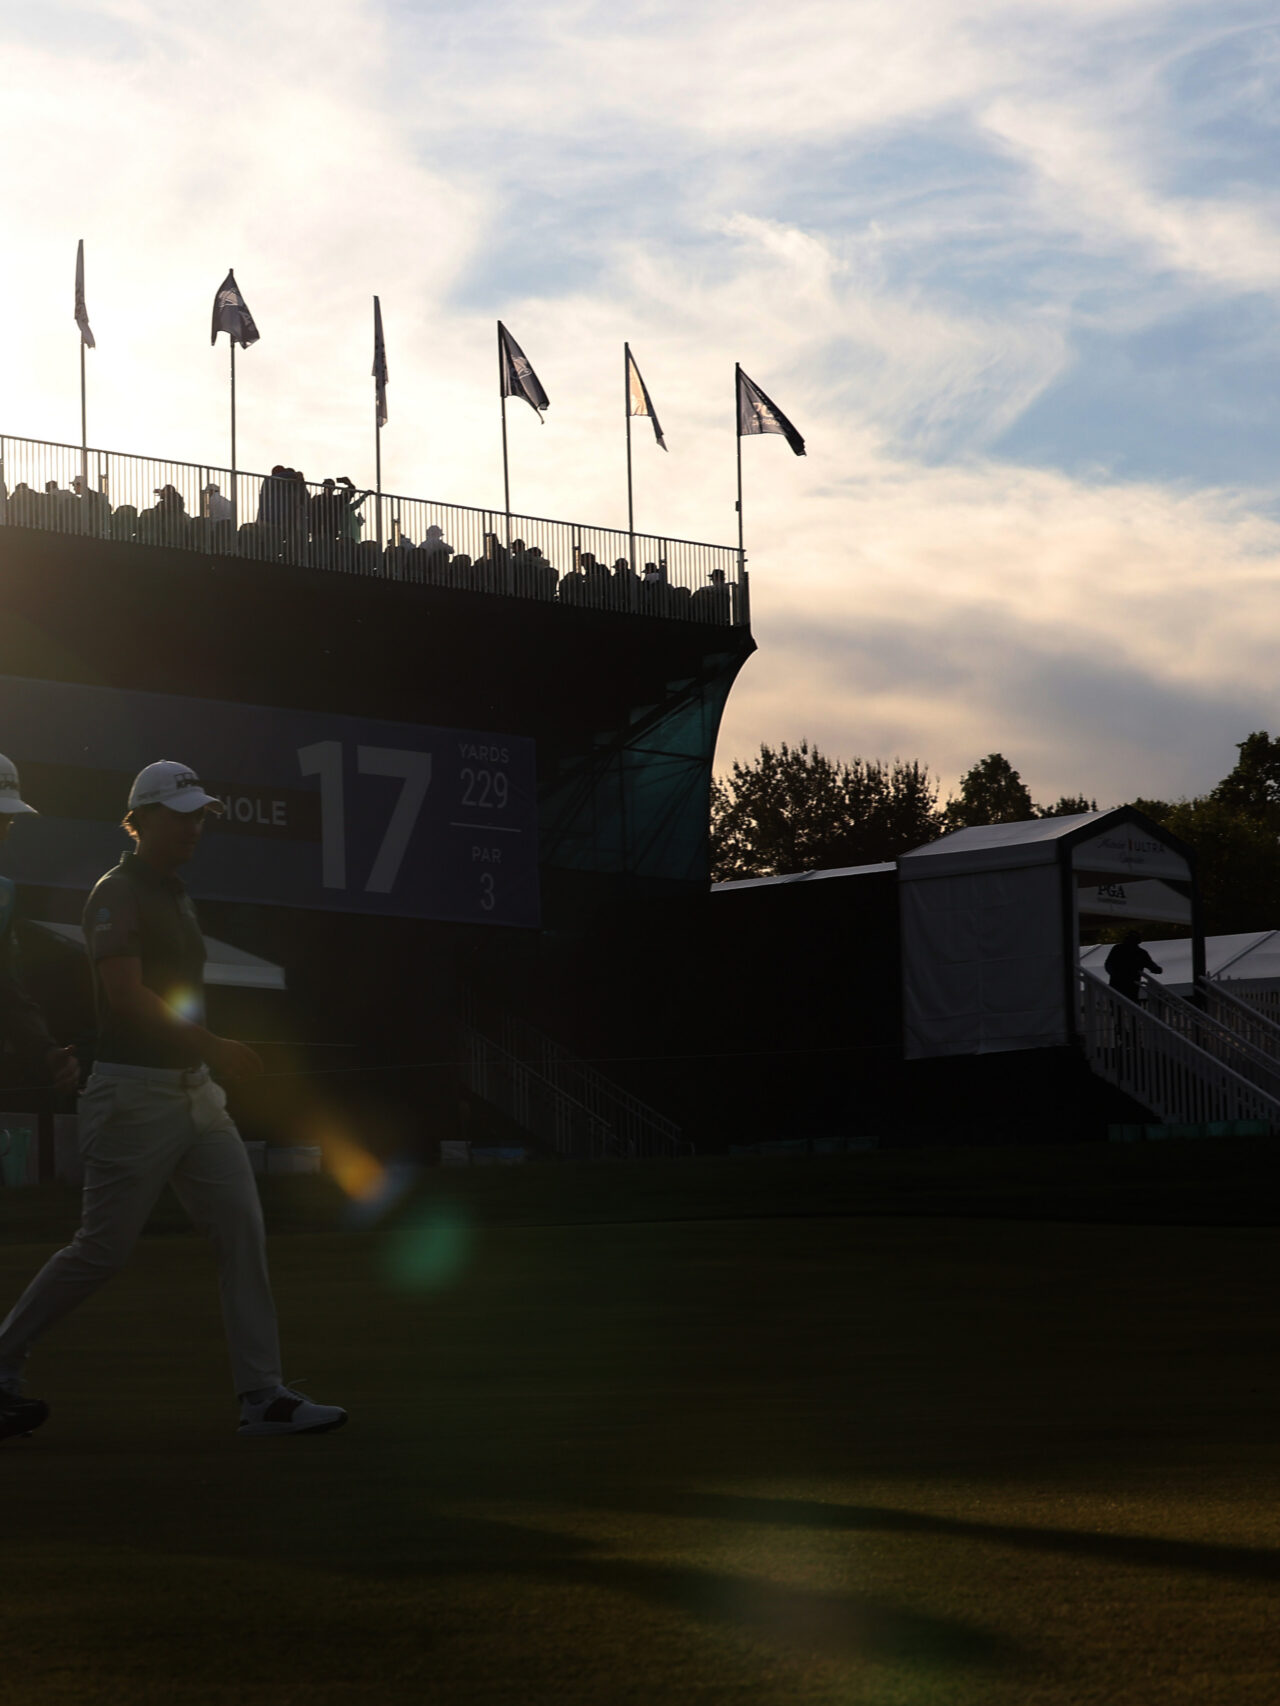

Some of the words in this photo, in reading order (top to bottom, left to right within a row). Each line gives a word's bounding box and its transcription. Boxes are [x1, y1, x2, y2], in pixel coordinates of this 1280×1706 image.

[458, 743, 510, 763] YARDS
[460, 768, 508, 808] 229
[296, 740, 432, 894] 17
[472, 846, 502, 864] PAR
[479, 872, 495, 911] 3
[1097, 884, 1126, 898] PGA
